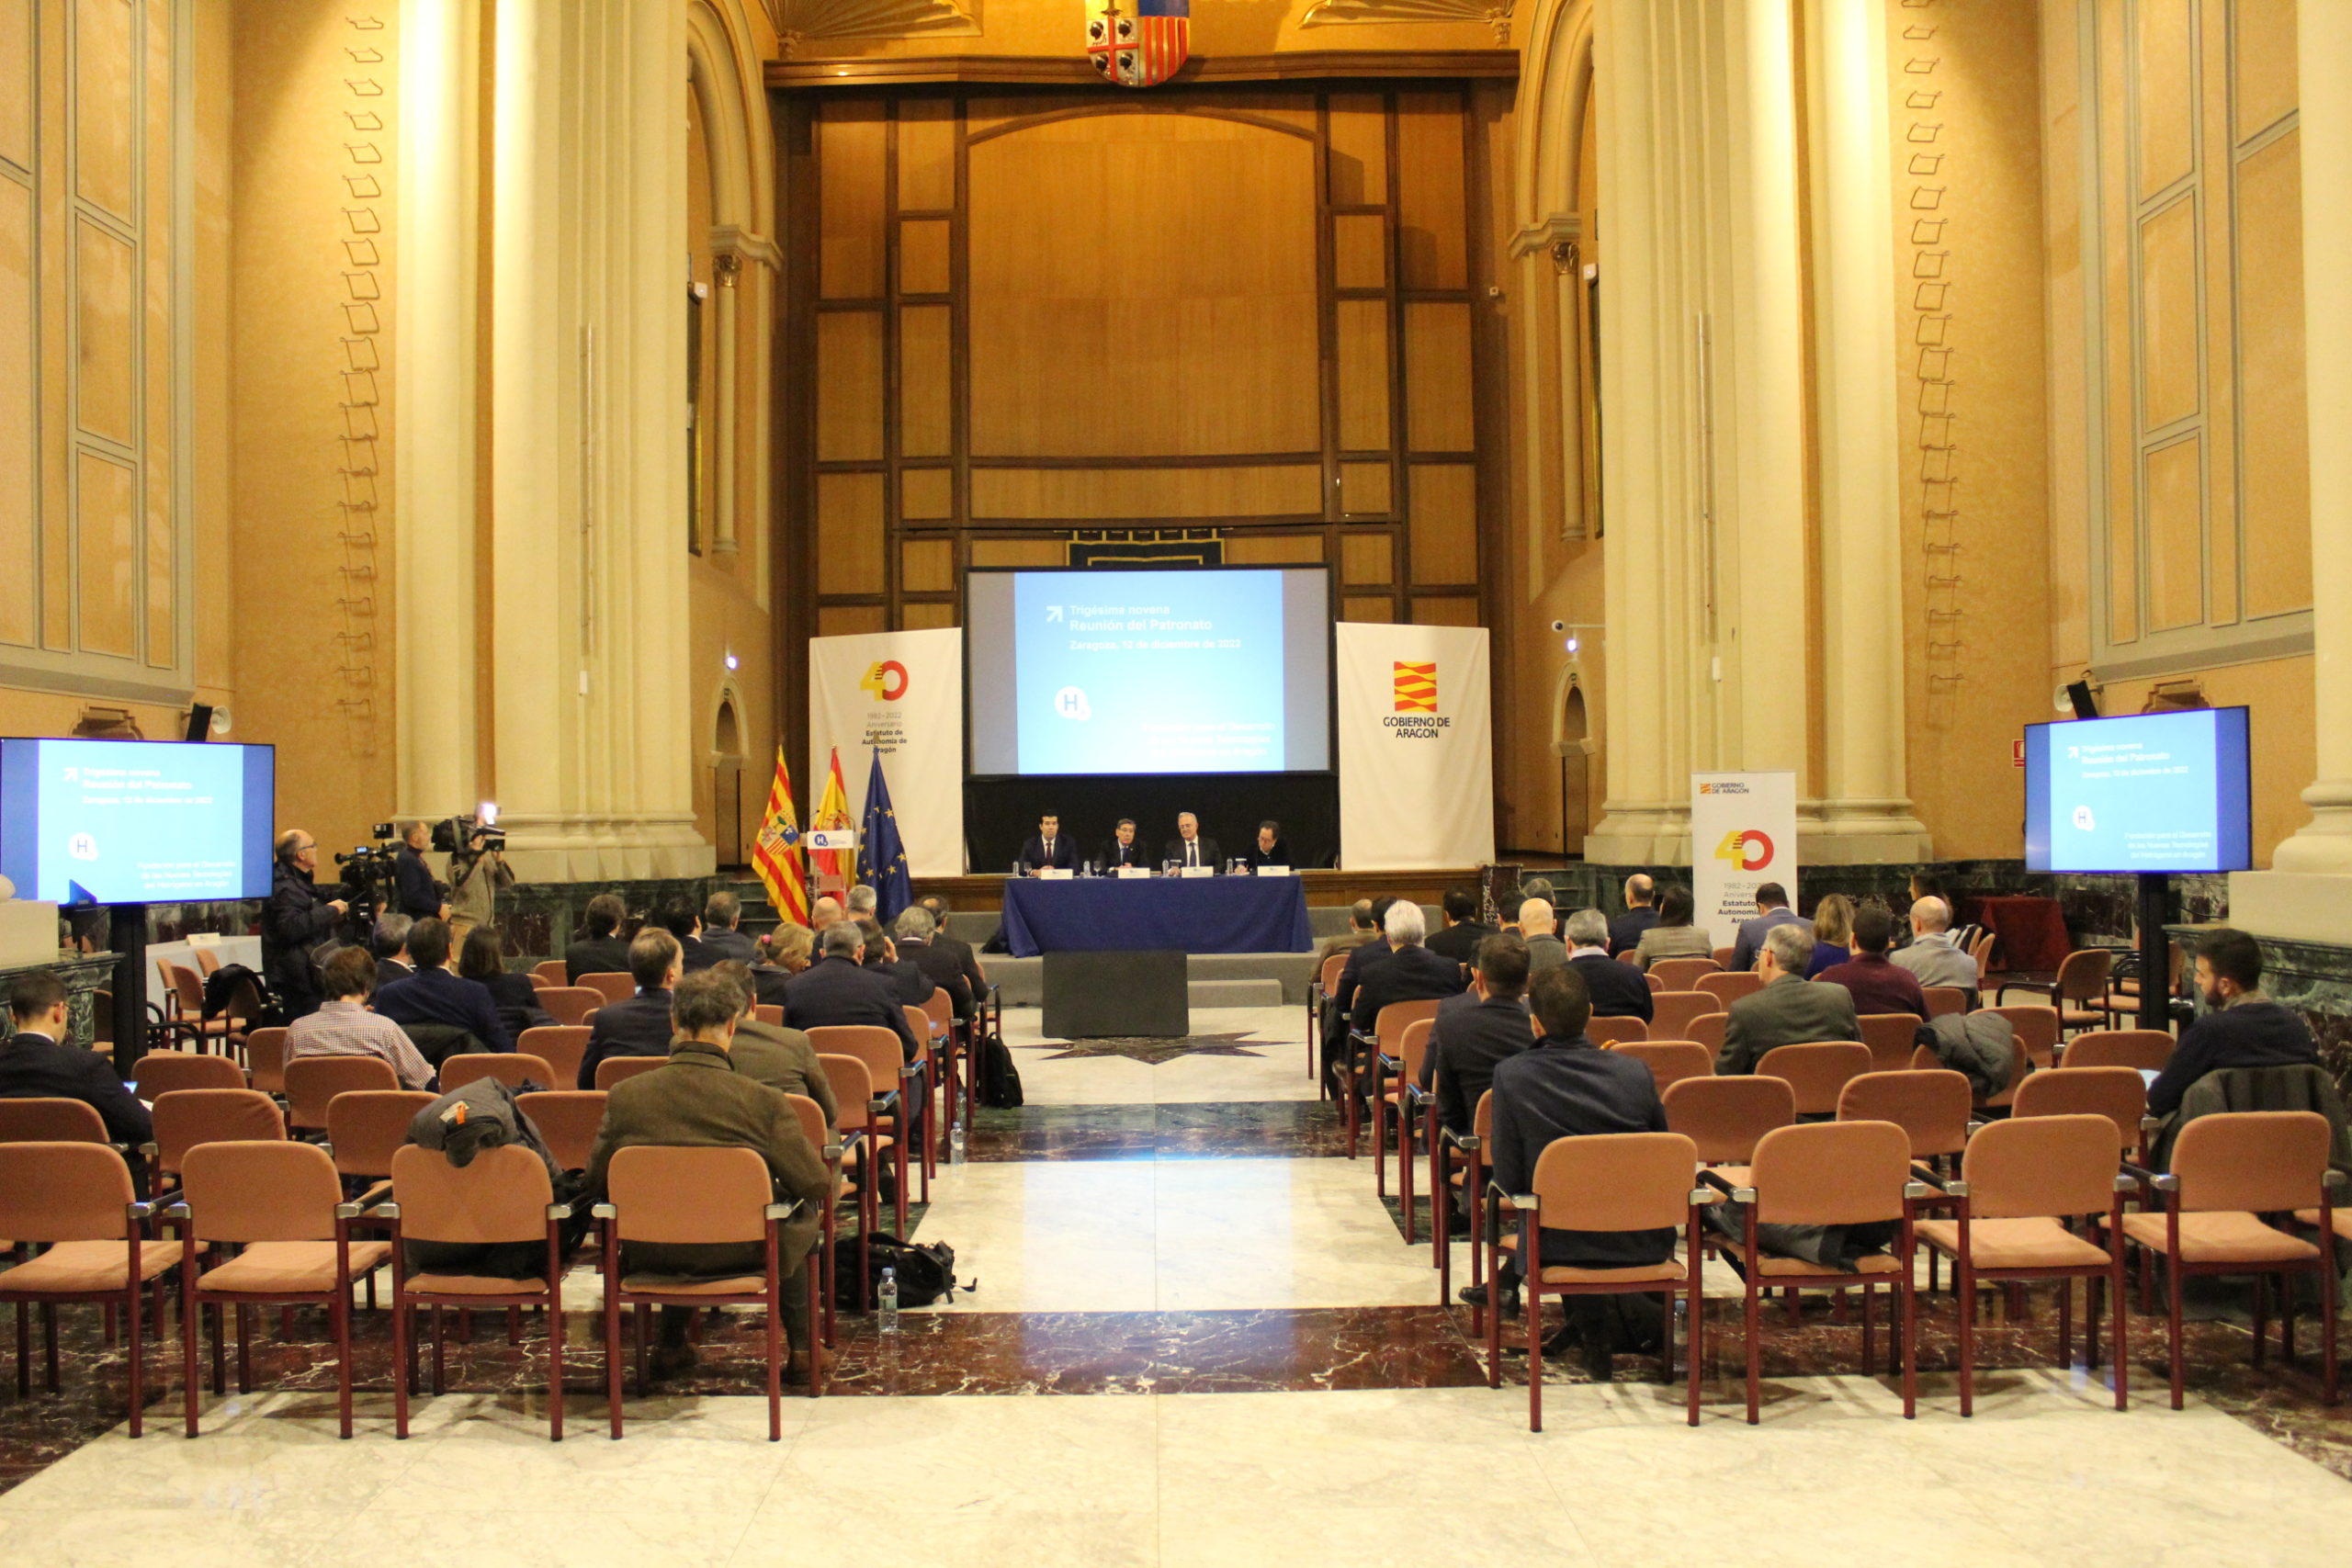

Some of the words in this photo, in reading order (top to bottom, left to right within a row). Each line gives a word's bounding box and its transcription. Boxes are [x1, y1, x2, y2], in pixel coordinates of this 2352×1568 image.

[1069, 605, 1125, 617] Trigésima
[1128, 606, 1170, 615] novena
[1069, 618, 1123, 631] Reunión
[1126, 619, 1145, 631] del
[1149, 618, 1213, 631] Patronato
[1383, 716, 1435, 728] GOBIERNO
[1437, 716, 1450, 728] DE
[1396, 728, 1439, 739] ARAGON
[1714, 829, 1774, 871] 40
